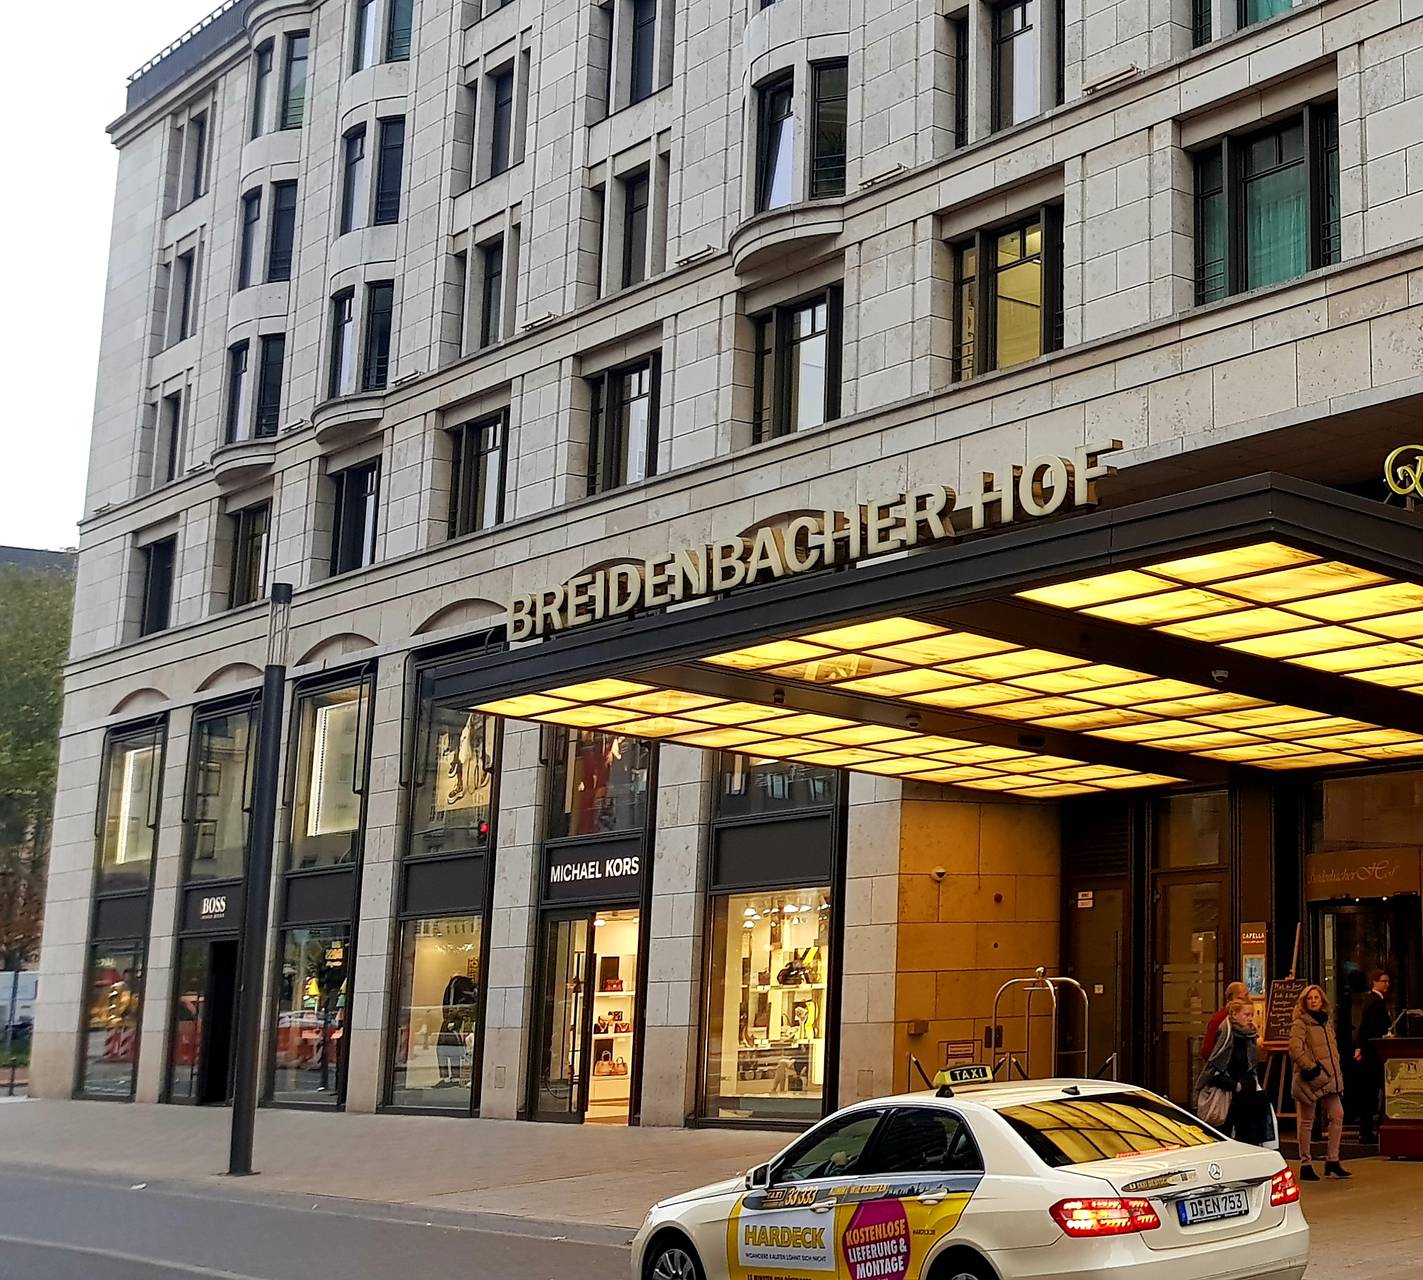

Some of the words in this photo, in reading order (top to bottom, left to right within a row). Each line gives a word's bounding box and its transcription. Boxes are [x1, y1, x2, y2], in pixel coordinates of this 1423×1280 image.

[506, 483, 956, 642] BREIDENBACHER
[971, 439, 1122, 530] HOF
[550, 861, 602, 882] MICHAEL
[605, 857, 640, 878] KORS
[202, 896, 227, 914] BOSS
[954, 1068, 984, 1080] TAXI
[1221, 1194, 1243, 1211] 753
[745, 1225, 826, 1249] HARDECK
[845, 1219, 906, 1246] KOSTENLOSE
[848, 1240, 898, 1263] LIEFERUNG
[899, 1237, 907, 1253] &
[856, 1255, 905, 1280] MONTAGE
